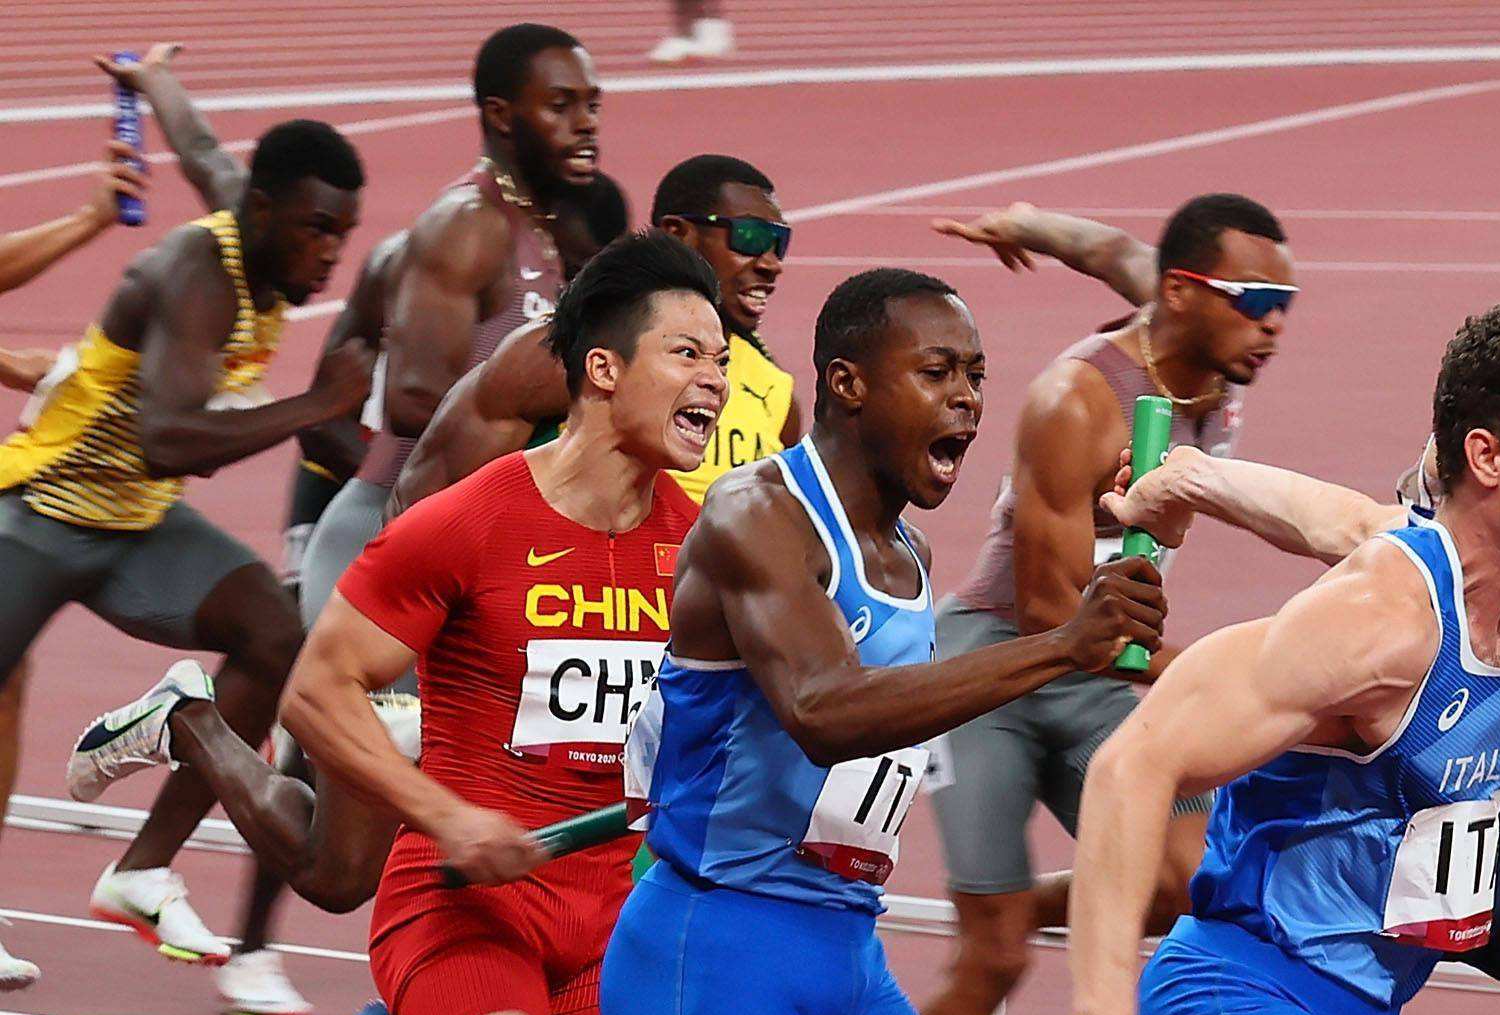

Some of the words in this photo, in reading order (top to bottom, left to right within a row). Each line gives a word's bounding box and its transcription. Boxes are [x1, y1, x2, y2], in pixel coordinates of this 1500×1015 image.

[702, 425, 764, 468] ICA
[525, 583, 670, 632] CHIN
[568, 750, 597, 763] TOKYO
[853, 755, 913, 837] IT
[1434, 816, 1498, 895] IT
